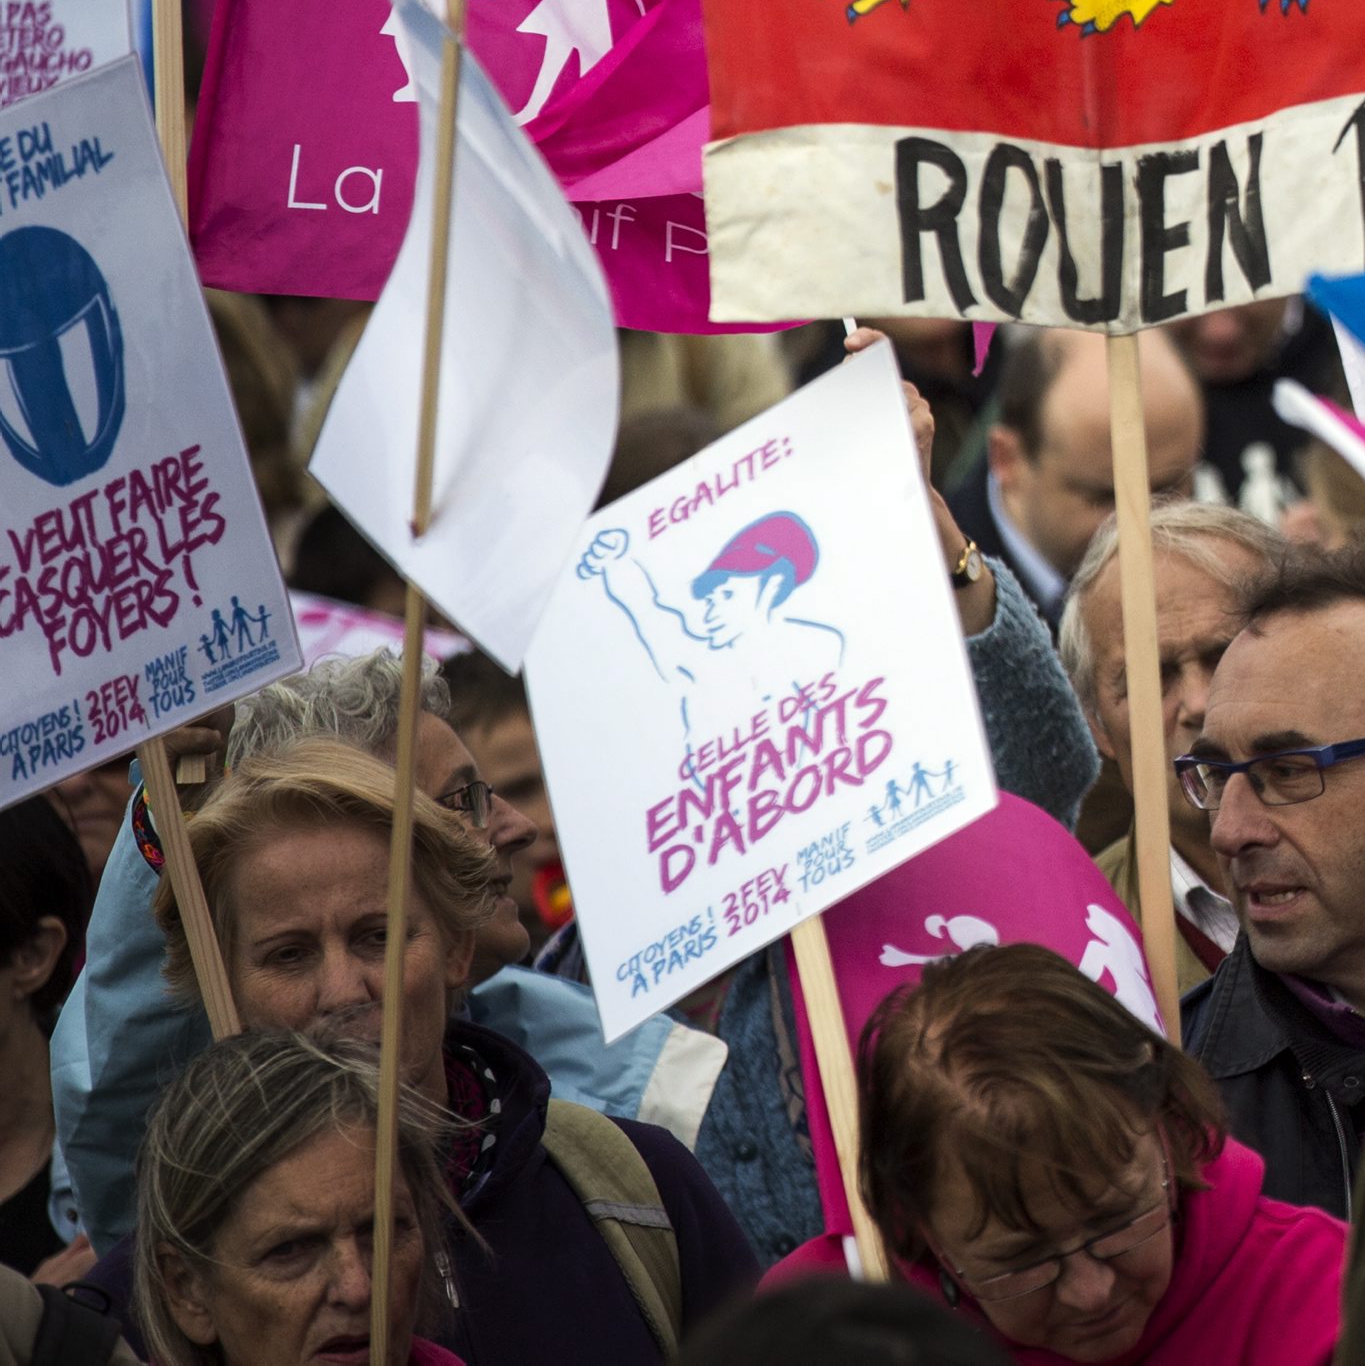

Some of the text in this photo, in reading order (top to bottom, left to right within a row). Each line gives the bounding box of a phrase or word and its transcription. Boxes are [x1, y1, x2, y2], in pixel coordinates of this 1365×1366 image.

[7, 0, 52, 27] PAS
[6, 137, 115, 210] FAMILIAL
[17, 122, 53, 162] DU
[287, 144, 383, 215] La
[895, 131, 1272, 324] ROUEN
[7, 444, 209, 573] VEUT FAIRE
[157, 491, 226, 565] LES
[48, 568, 180, 676] FOYERS
[144, 646, 188, 681] MANIF
[153, 666, 194, 694] POUR
[91, 697, 146, 746] 2014
[149, 679, 196, 719] TOUS
[679, 672, 837, 782] CELLE DES
[29, 725, 86, 774] PARIS
[646, 677, 888, 855] ENFANTS
[660, 729, 893, 896] D'ABORD
[797, 820, 852, 866] MANIF
[798, 852, 855, 894] TOUS
[726, 886, 791, 937] 2014
[616, 913, 700, 983] CITOYENS
[631, 927, 718, 998] A PARIS
